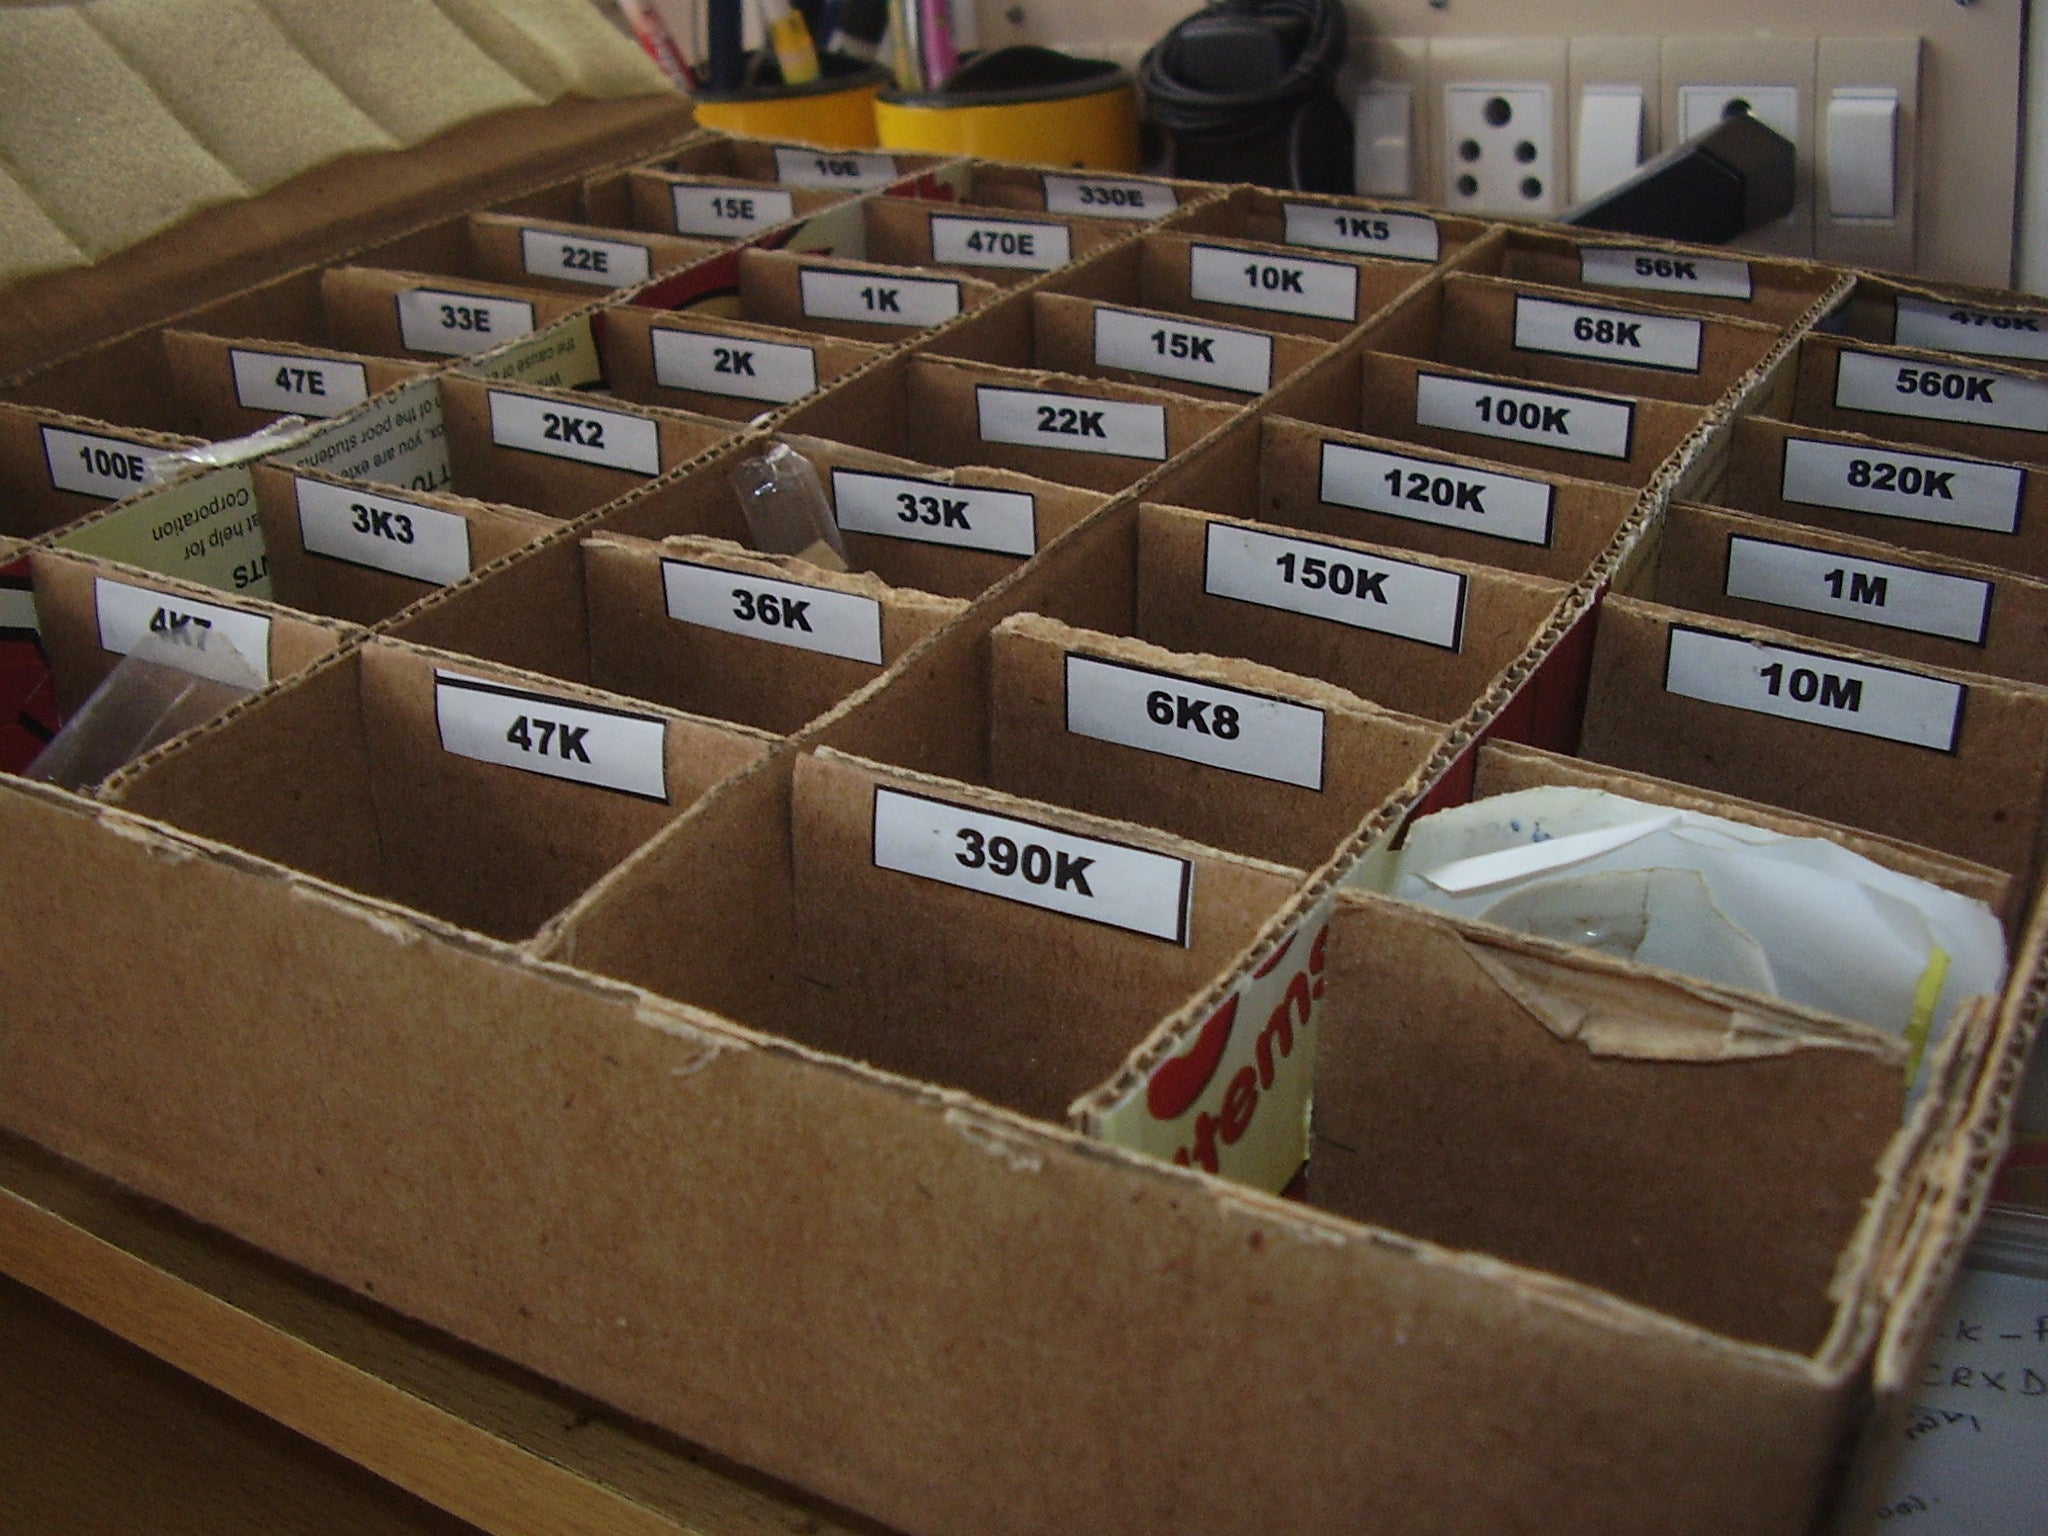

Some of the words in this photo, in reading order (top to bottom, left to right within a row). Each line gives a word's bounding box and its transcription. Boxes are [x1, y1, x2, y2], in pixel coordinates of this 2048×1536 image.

[815, 158, 859, 179] 10E
[711, 197, 755, 220] 15E
[1079, 186, 1143, 209] 330E
[967, 230, 1034, 256] 470E
[1335, 217, 1390, 240] 1K5
[562, 246, 608, 272] 22E
[1635, 258, 1697, 280] 56K
[1245, 266, 1303, 294] 10K
[861, 289, 901, 313] 1K
[441, 305, 490, 332] 33E
[1574, 317, 1640, 347] 68K
[1150, 330, 1214, 363] 15K
[713, 349, 756, 375] 2K
[275, 366, 326, 395] 47E
[1896, 370, 1994, 404] 560K
[361, 416, 392, 445] poor
[396, 409, 417, 428] the
[1037, 406, 1106, 437] 22K
[1475, 397, 1570, 434] 100K
[399, 432, 423, 456] you
[543, 414, 605, 448] 2K2
[80, 447, 144, 481] 100E
[373, 447, 395, 468] are
[1384, 469, 1486, 513] 120K
[1848, 460, 1954, 499] 820K
[152, 488, 250, 543] Corporation
[352, 505, 415, 544] 3K3
[897, 494, 971, 529] 33K
[208, 522, 243, 548] help
[183, 539, 206, 562] for
[1276, 554, 1389, 605] 150K
[1824, 569, 1887, 606] 1M
[732, 590, 813, 632] 36K
[1760, 663, 1863, 712] 10M
[1146, 691, 1239, 740] 6K8
[507, 716, 591, 764] 47K
[955, 828, 1094, 897] 390K
